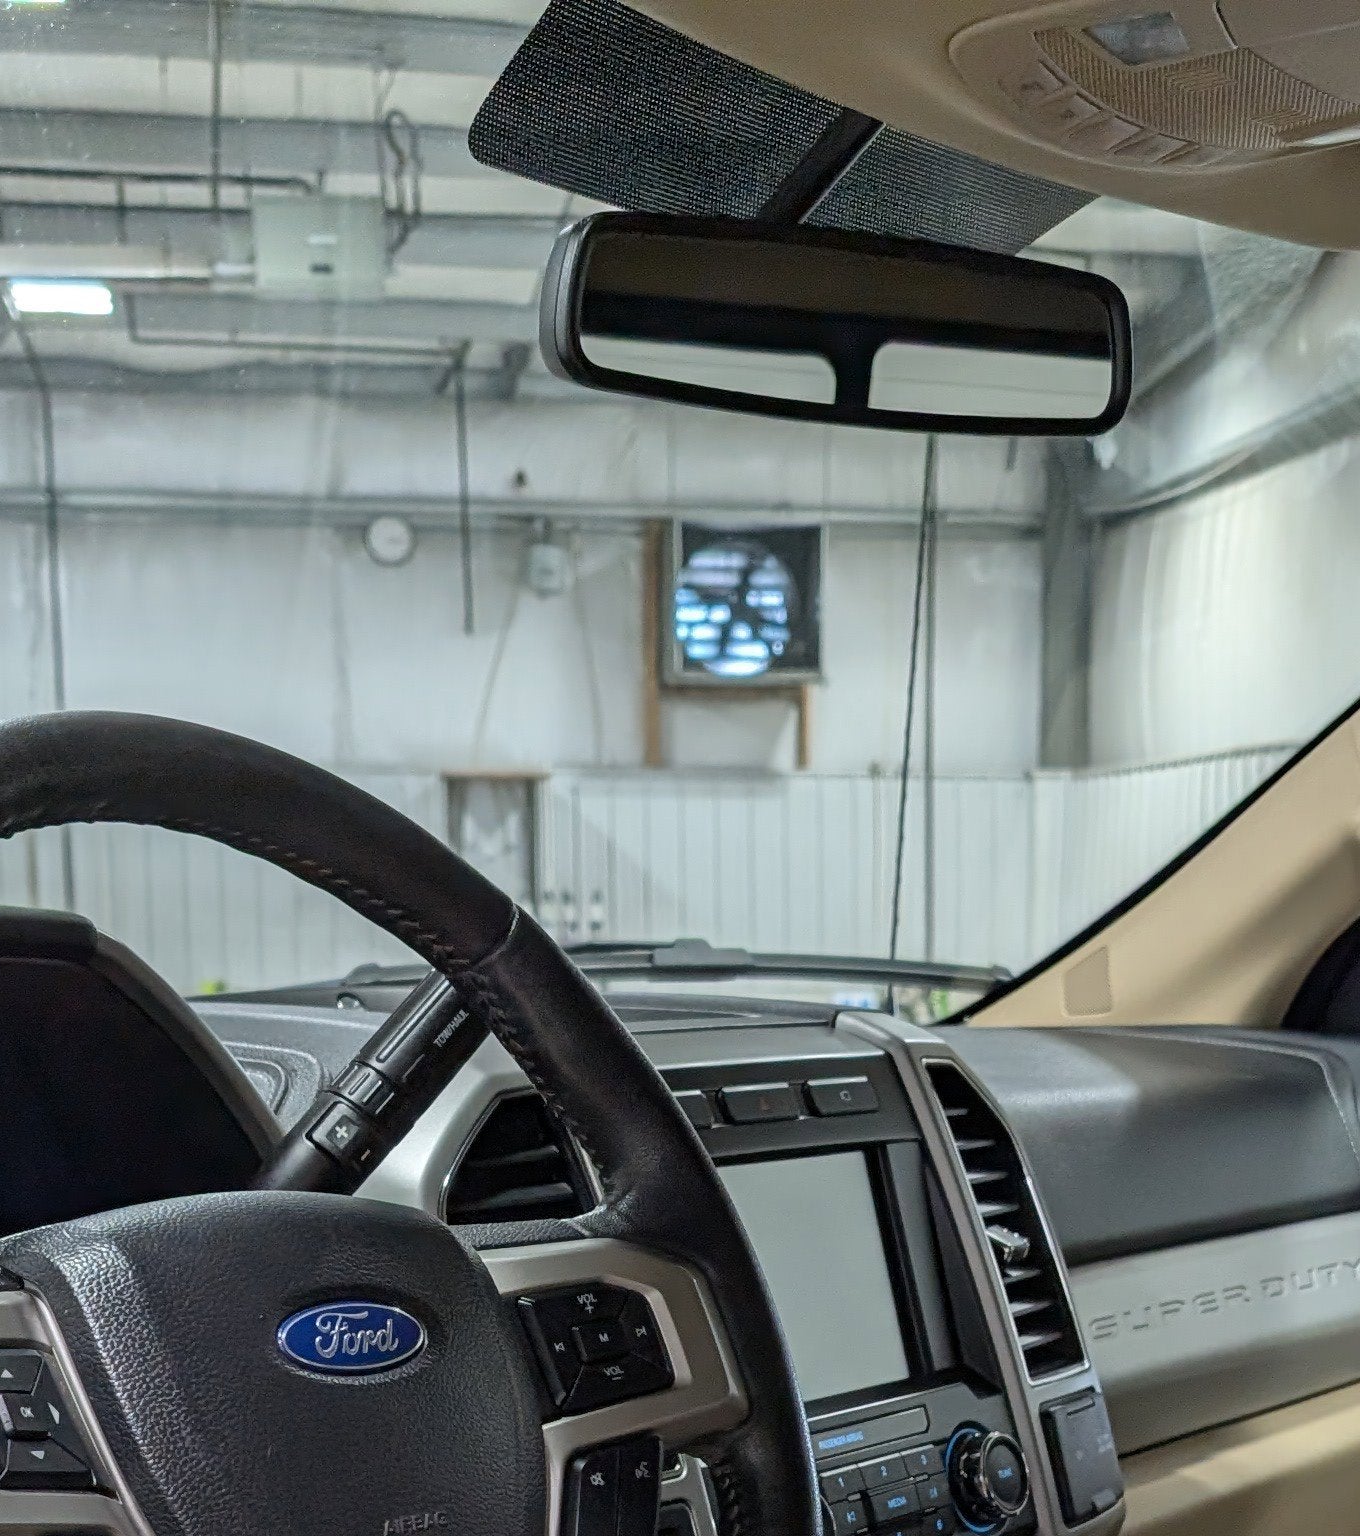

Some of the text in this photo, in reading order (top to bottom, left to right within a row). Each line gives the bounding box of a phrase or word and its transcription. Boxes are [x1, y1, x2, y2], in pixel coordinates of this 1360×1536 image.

[577, 1292, 598, 1305] VOL
[1089, 1284, 1251, 1341] SUPER
[314, 1310, 400, 1359] Ford
[597, 1332, 610, 1343] M
[603, 1364, 625, 1377] VOL
